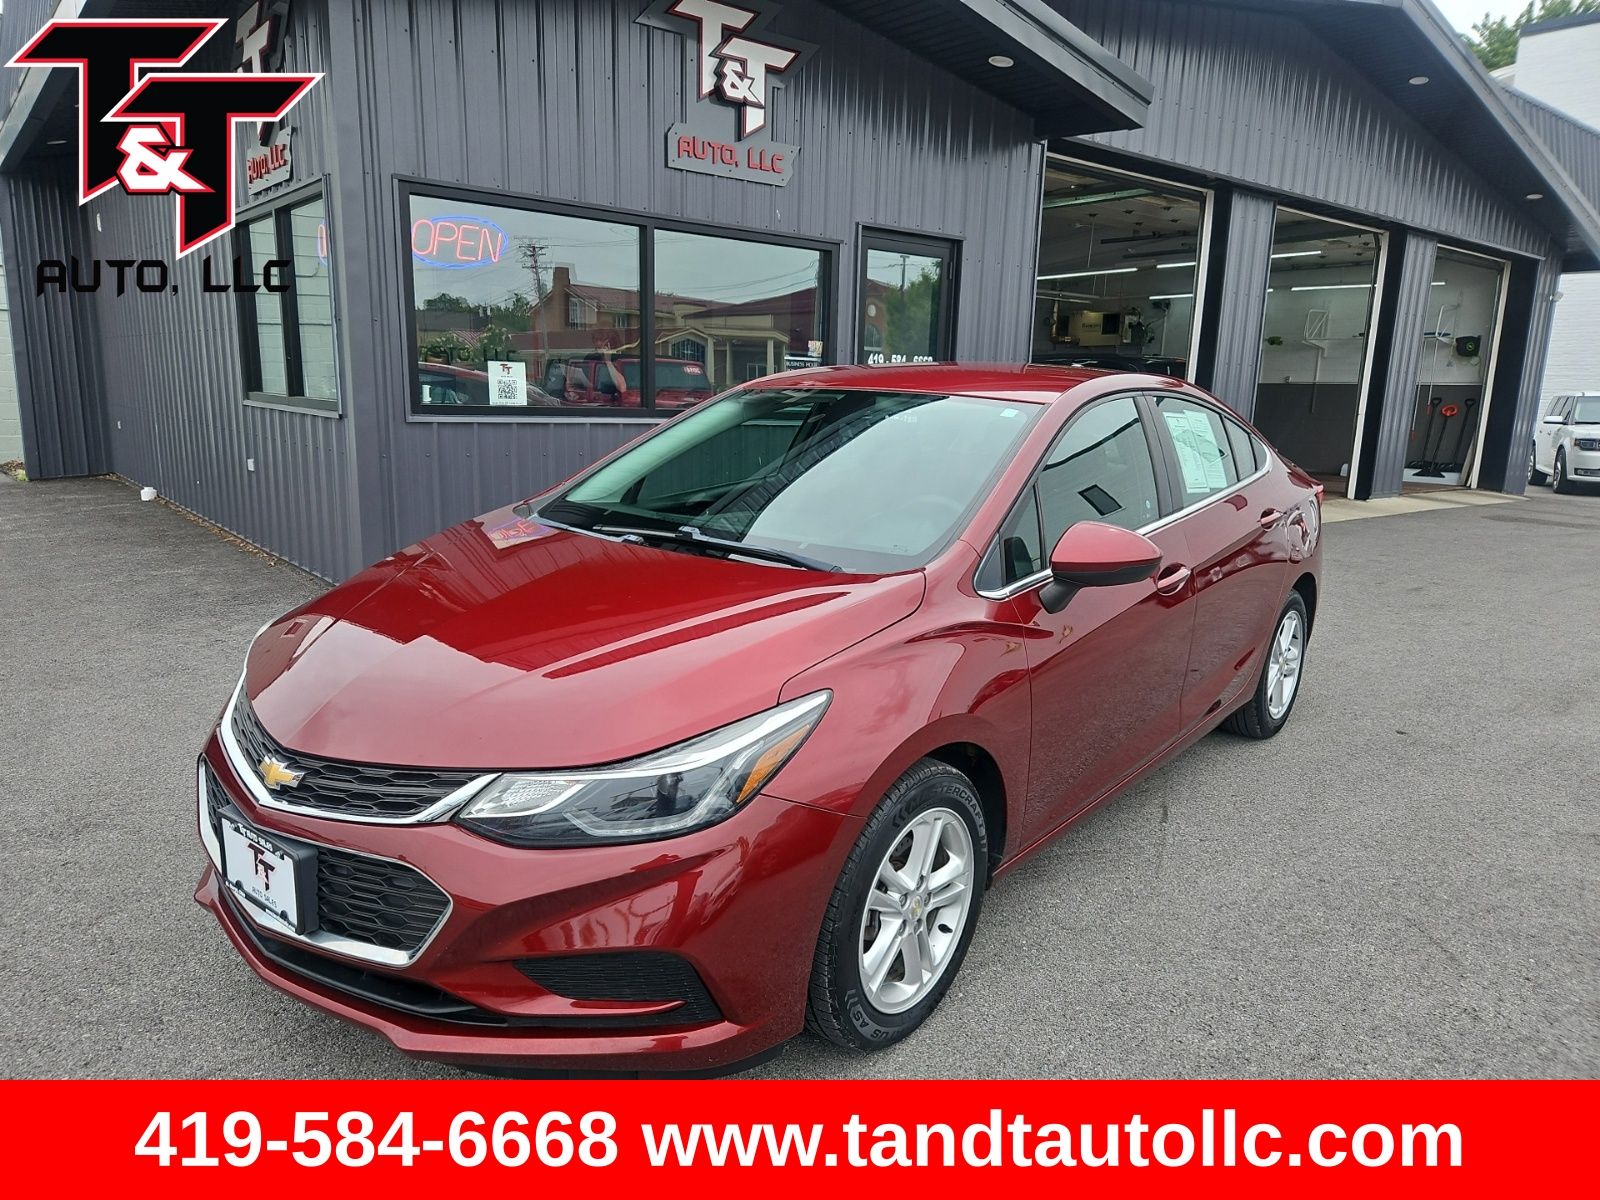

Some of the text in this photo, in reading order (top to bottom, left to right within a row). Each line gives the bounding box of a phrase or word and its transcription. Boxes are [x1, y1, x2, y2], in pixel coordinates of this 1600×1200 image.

[667, 0, 801, 138] T&T
[268, 144, 287, 170] LLC
[677, 135, 785, 174] AUTO, LLC
[411, 219, 502, 262] OPEN
[867, 352, 884, 364] 419
